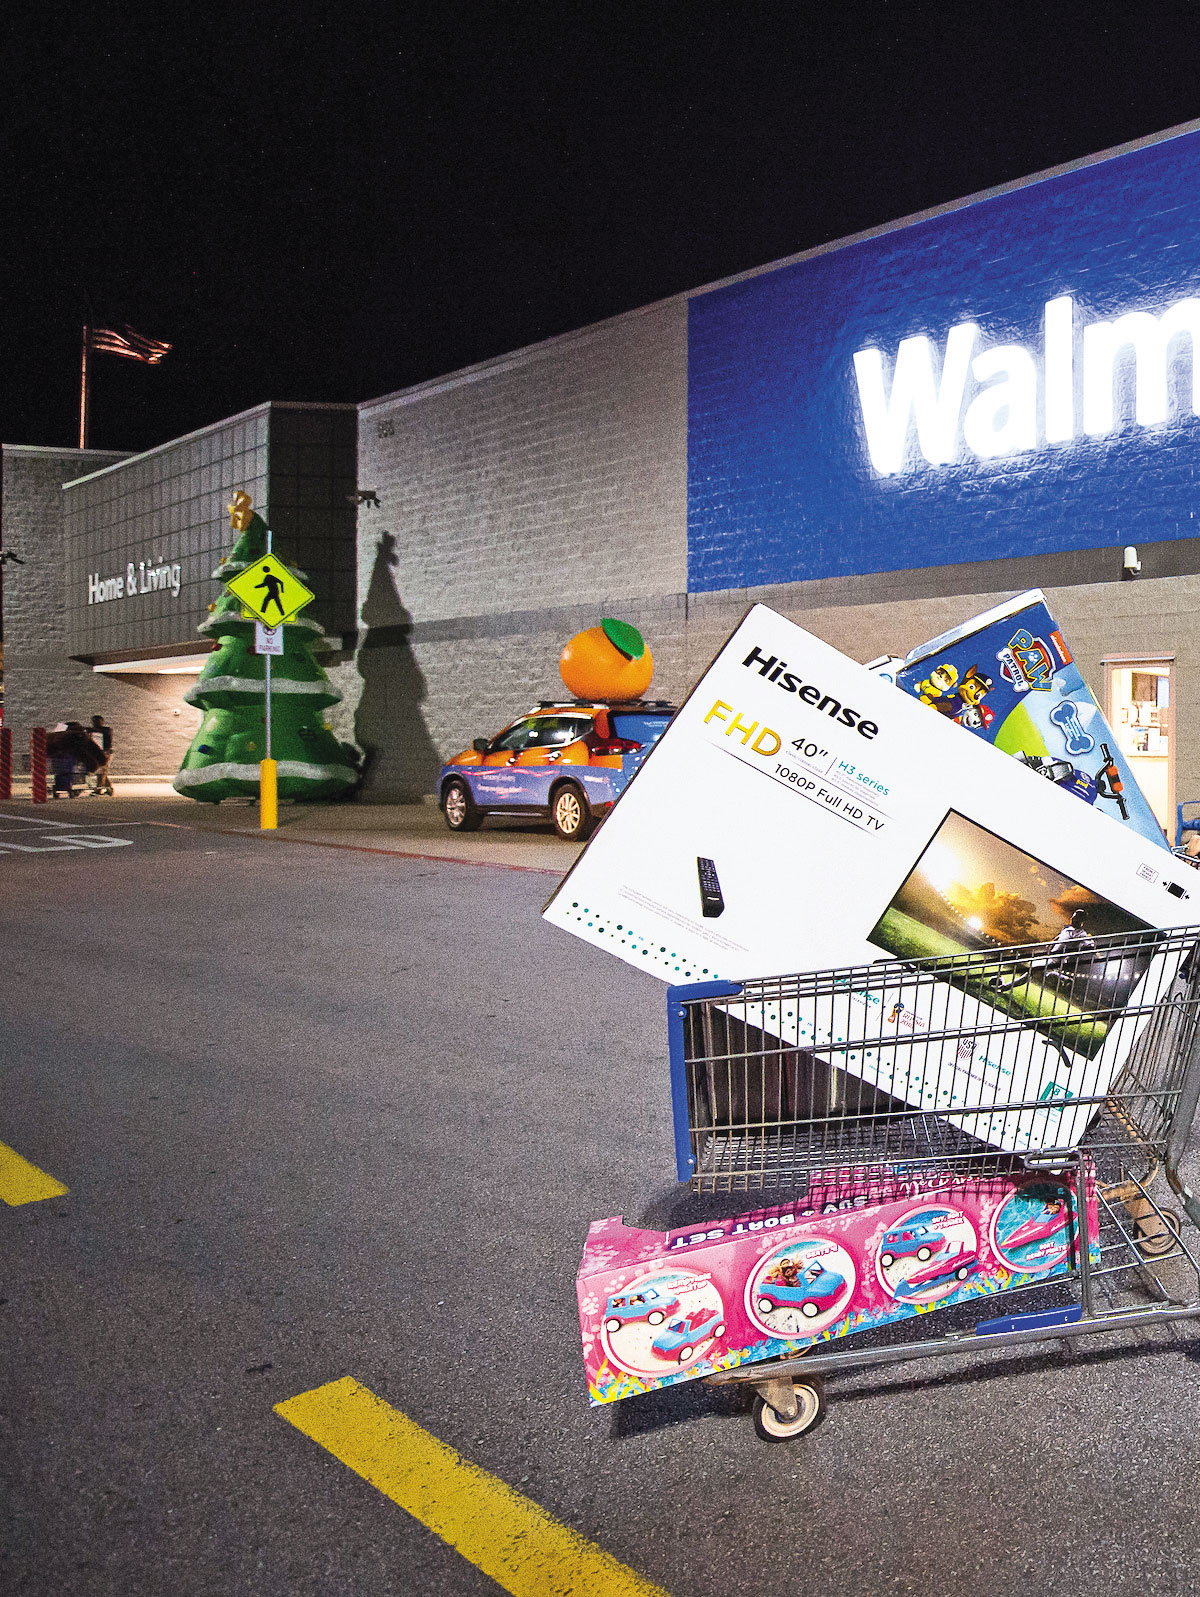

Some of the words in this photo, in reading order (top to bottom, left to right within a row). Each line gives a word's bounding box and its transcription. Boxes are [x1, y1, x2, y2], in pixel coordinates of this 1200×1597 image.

[88, 573, 124, 604] Home
[127, 563, 137, 596] &
[140, 556, 181, 597] Living
[1003, 653, 1024, 686] PATROL
[1008, 628, 1052, 691] PAW
[742, 646, 879, 740] Hisense
[704, 699, 781, 756] FHD
[775, 763, 816, 790] 1080P
[817, 788, 842, 808] Full
[843, 803, 862, 819] HD
[867, 815, 885, 831] TV
[838, 761, 856, 775] H3
[857, 772, 890, 796] series
[732, 1213, 795, 1235] BOAT
[822, 1195, 868, 1215] SUV
[671, 1228, 724, 1250] SET
